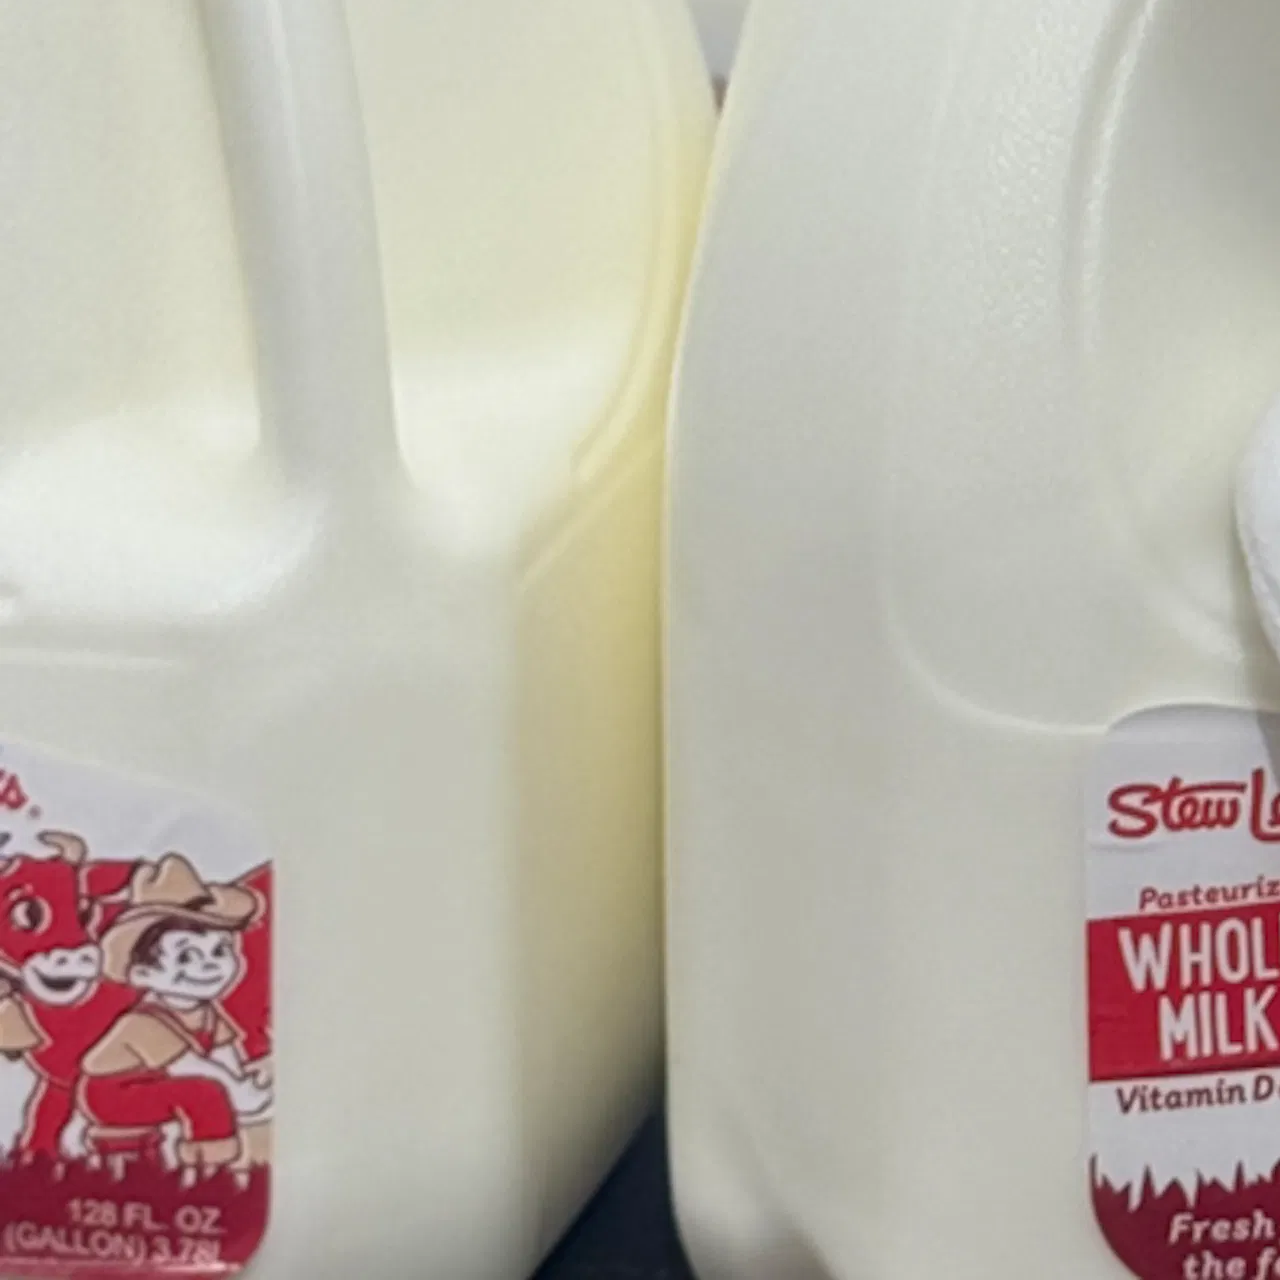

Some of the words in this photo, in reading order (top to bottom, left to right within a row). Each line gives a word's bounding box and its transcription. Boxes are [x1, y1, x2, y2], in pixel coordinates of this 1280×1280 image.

[1107, 776, 1246, 838] Stew
[1157, 985, 1279, 1062] MILK
[1115, 1080, 1246, 1114] Vitamin
[67, 1197, 118, 1228] 128
[1168, 1209, 1276, 1244] Fresh
[3, 1220, 148, 1268] (GALLON)
[1184, 1249, 1248, 1280] the
